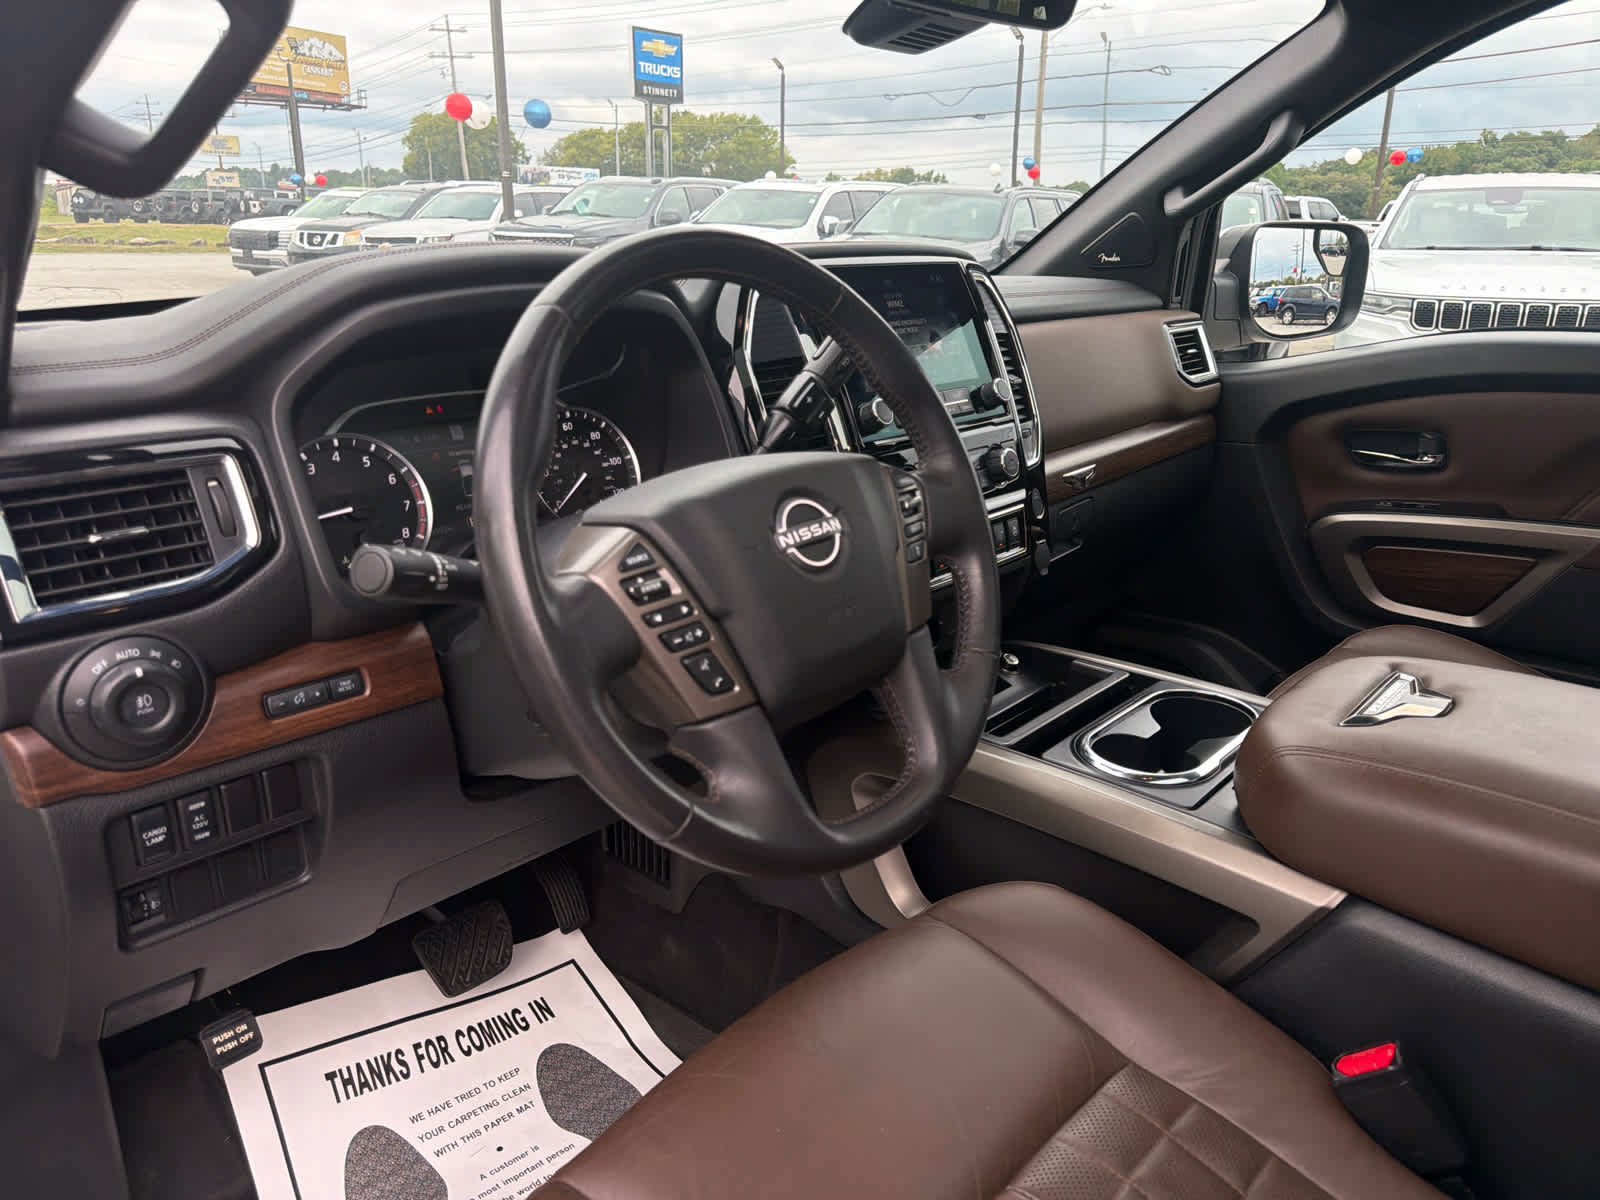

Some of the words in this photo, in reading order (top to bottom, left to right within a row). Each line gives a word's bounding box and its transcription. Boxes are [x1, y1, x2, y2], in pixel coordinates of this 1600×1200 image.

[638, 62, 681, 78] TRUCKS
[562, 422, 573, 431] 60
[590, 432, 600, 440] 80
[332, 451, 340, 462] 4
[362, 456, 371, 467] 5
[307, 464, 315, 475] 3
[388, 474, 396, 485] 6
[403, 500, 410, 512] 7
[402, 528, 409, 538] 8
[778, 518, 841, 548] NISSAN
[116, 648, 140, 660] AUTO
[91, 660, 107, 674] OFF
[142, 826, 167, 840] CARGO
[145, 835, 166, 847] LAMP
[212, 1030, 235, 1045] PUSH
[235, 1023, 248, 1034] ON
[216, 1039, 239, 1056] PUSH
[239, 1031, 255, 1044] OFF
[324, 1048, 411, 1104] THANKS
[412, 1035, 456, 1073] FOR
[455, 1008, 530, 1057] COMING
[527, 996, 556, 1024] IN
[408, 1112, 426, 1124] WE
[426, 1100, 454, 1117] HAVE
[454, 1087, 482, 1104] TRIED
[482, 1080, 496, 1090] TO
[496, 1067, 521, 1084] KEEP
[417, 1125, 446, 1143] YOUR
[447, 1099, 500, 1129] CARPETING
[501, 1083, 532, 1102] CLEAN
[433, 1141, 460, 1158] WITH
[460, 1129, 482, 1144] THIS
[483, 1111, 516, 1133] PAPER
[515, 1100, 536, 1114] MAT
[479, 1173, 488, 1181] A
[489, 1151, 529, 1176] customer
[530, 1145, 540, 1153] is
[477, 1183, 502, 1200] most
[502, 1160, 545, 1187] important
[545, 1143, 576, 1164] person
[516, 1178, 543, 1196] world
